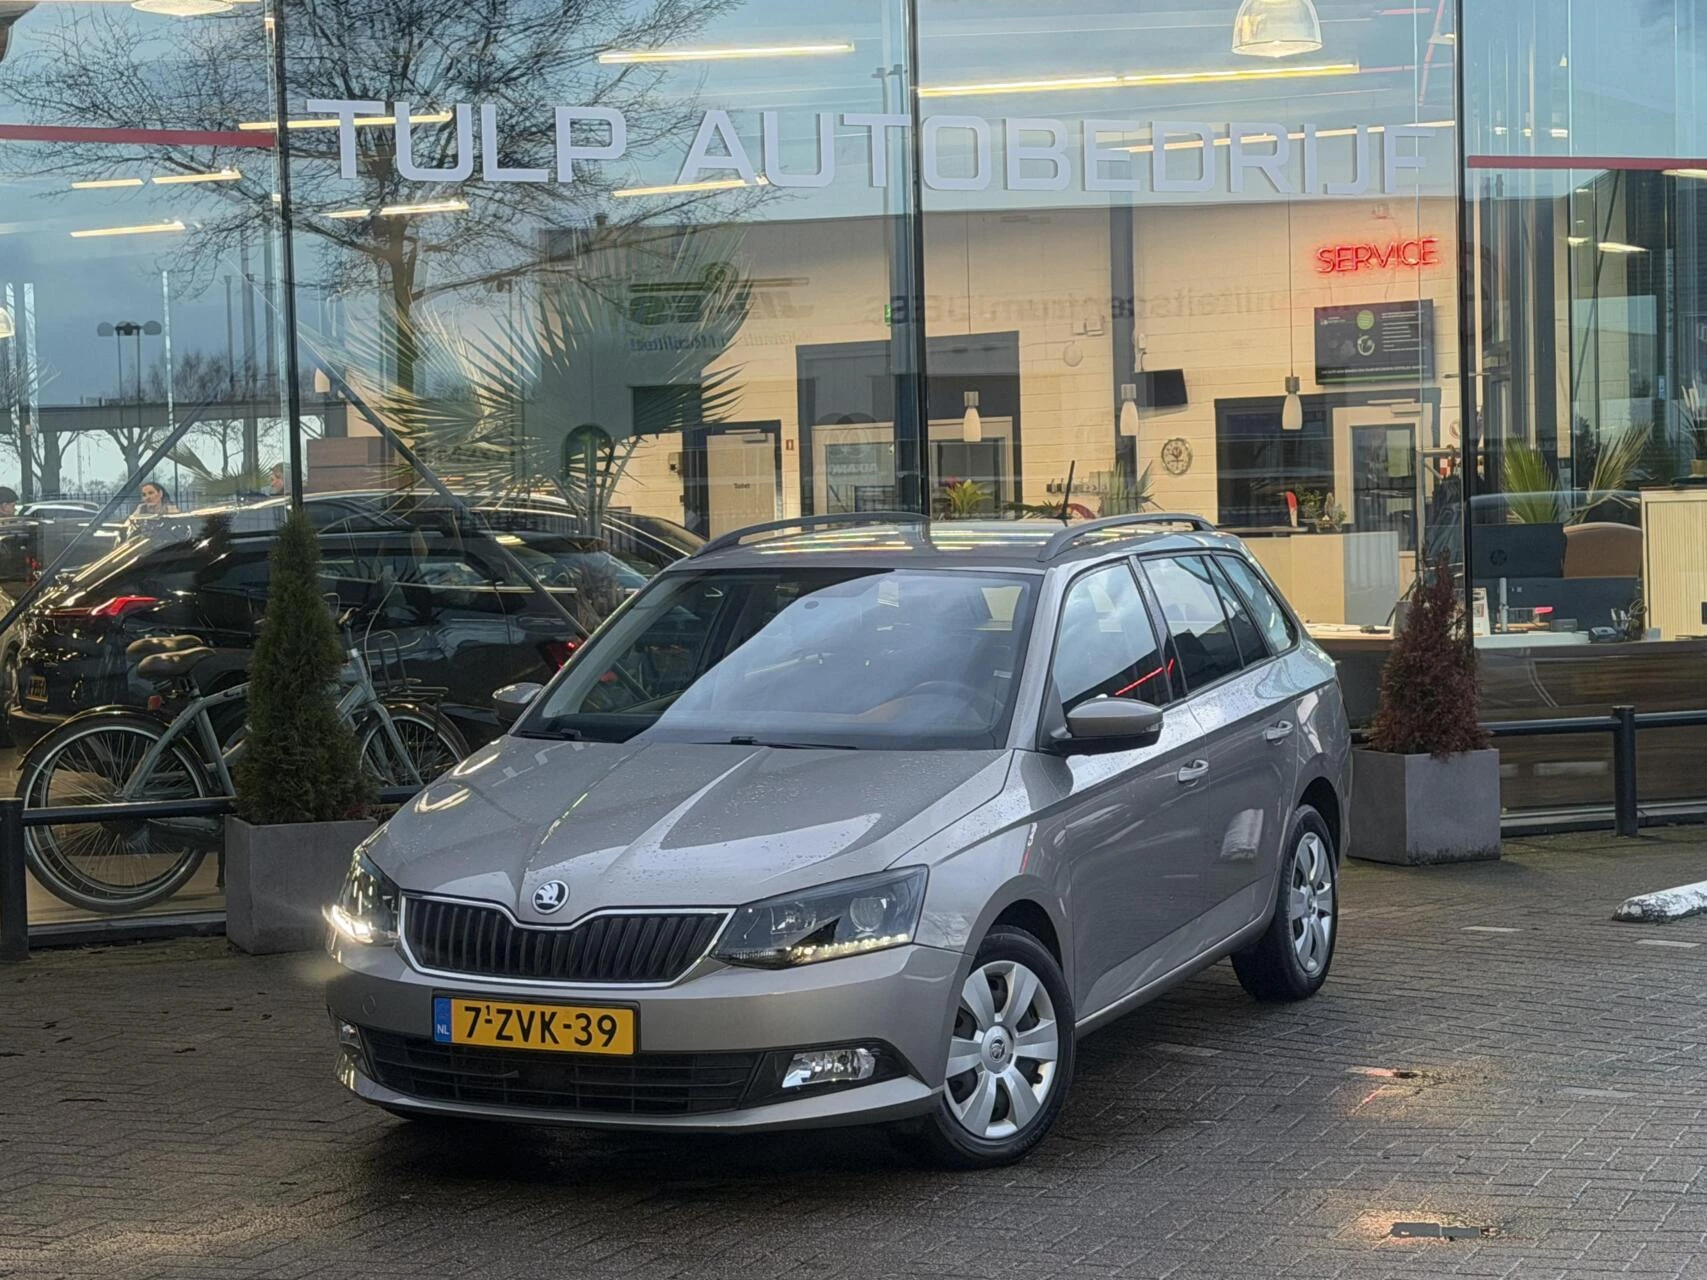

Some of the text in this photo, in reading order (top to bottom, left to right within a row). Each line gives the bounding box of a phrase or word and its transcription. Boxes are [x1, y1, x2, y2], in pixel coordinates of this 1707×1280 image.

[307, 99, 1437, 195] TULP AUTOBEDRIJF
[1316, 237, 1440, 274] SERVICE
[437, 1023, 451, 1036] NL
